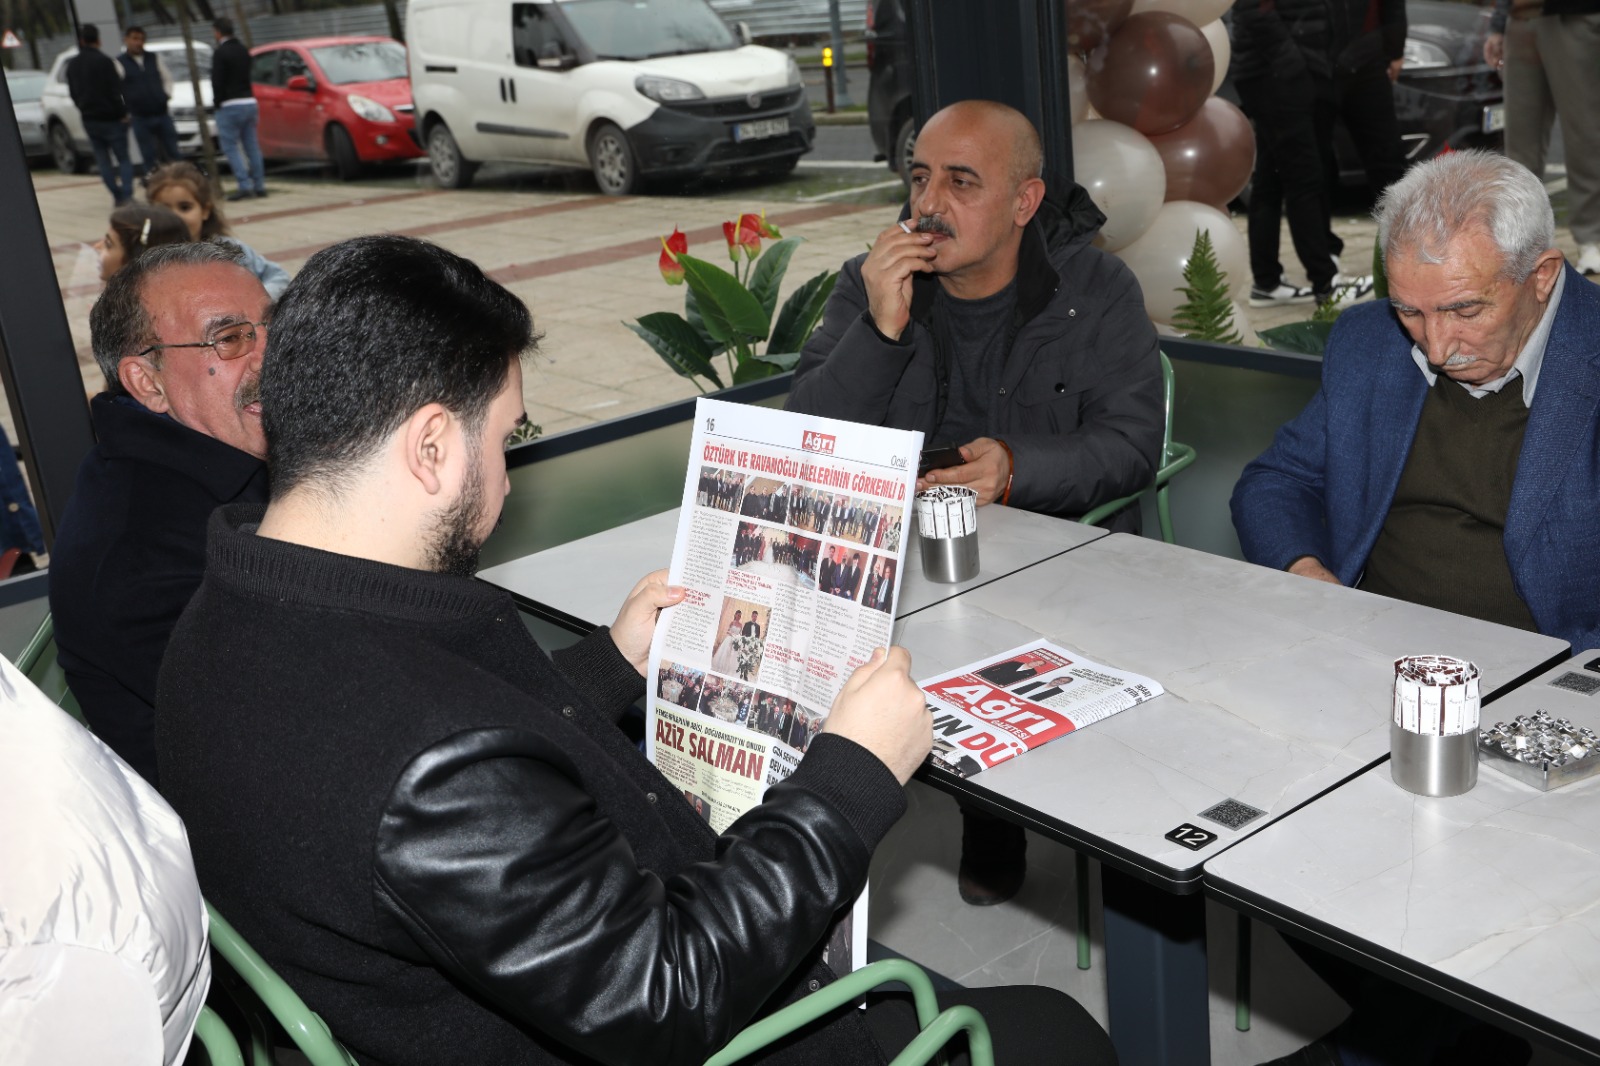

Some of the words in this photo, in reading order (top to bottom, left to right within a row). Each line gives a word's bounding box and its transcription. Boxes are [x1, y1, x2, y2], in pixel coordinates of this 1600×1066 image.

[706, 417, 715, 431] 16
[804, 432, 834, 451] Ağrı
[703, 441, 736, 466] ÖZTÜRK
[737, 450, 748, 468] VE
[750, 454, 799, 479] RAVANOĞLU
[799, 459, 851, 490] AİLELERİNİN
[851, 470, 898, 500] GÖRKEMLİ
[941, 684, 1057, 735] Ağrı
[990, 719, 1032, 741] GAZETESİ
[746, 740, 767, 754] ONURU
[689, 732, 765, 782] SALMAN
[769, 758, 782, 774] DEV
[1174, 827, 1209, 846] 12
